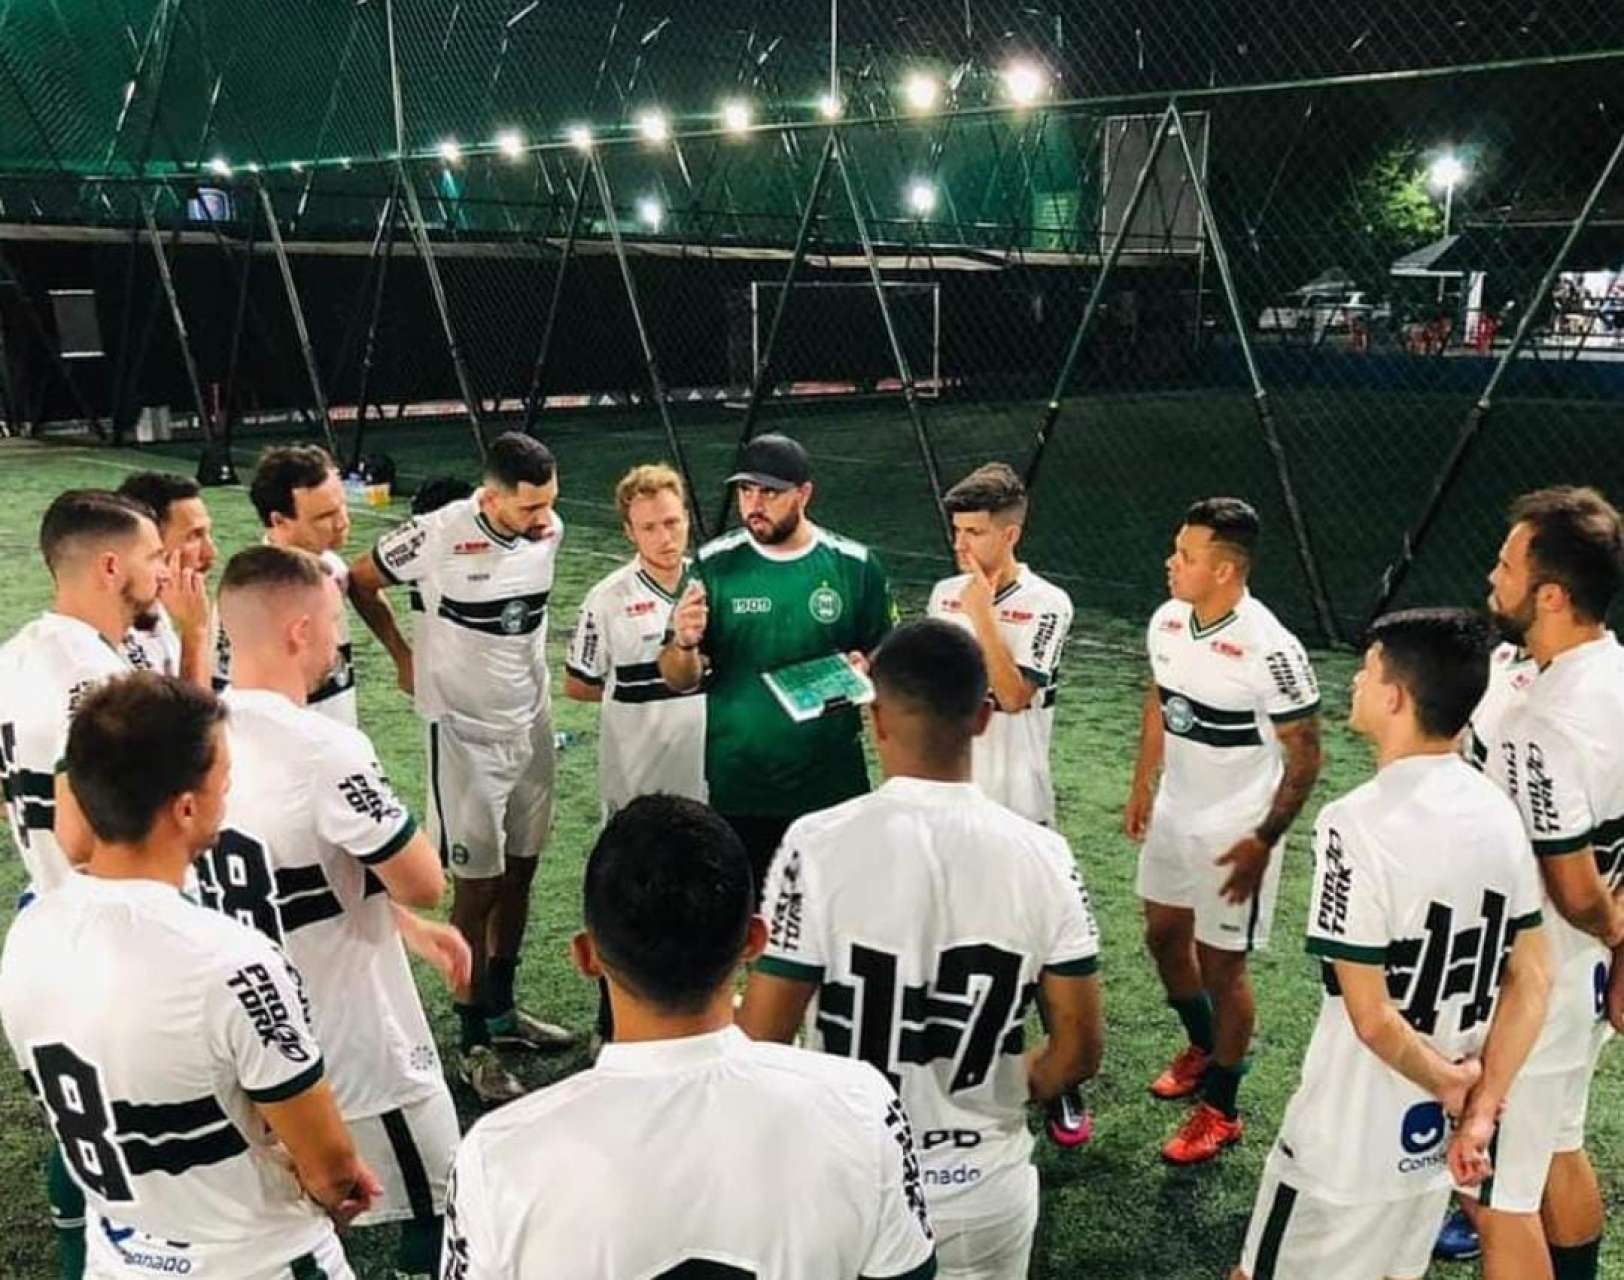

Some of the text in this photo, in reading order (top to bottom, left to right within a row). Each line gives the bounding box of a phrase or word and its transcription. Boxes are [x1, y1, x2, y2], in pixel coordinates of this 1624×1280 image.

[227, 969, 281, 1048] TORK
[244, 963, 289, 1021] PRO
[849, 942, 1024, 1098] 17
[1398, 890, 1506, 1036] 11
[32, 1042, 135, 1202] 8
